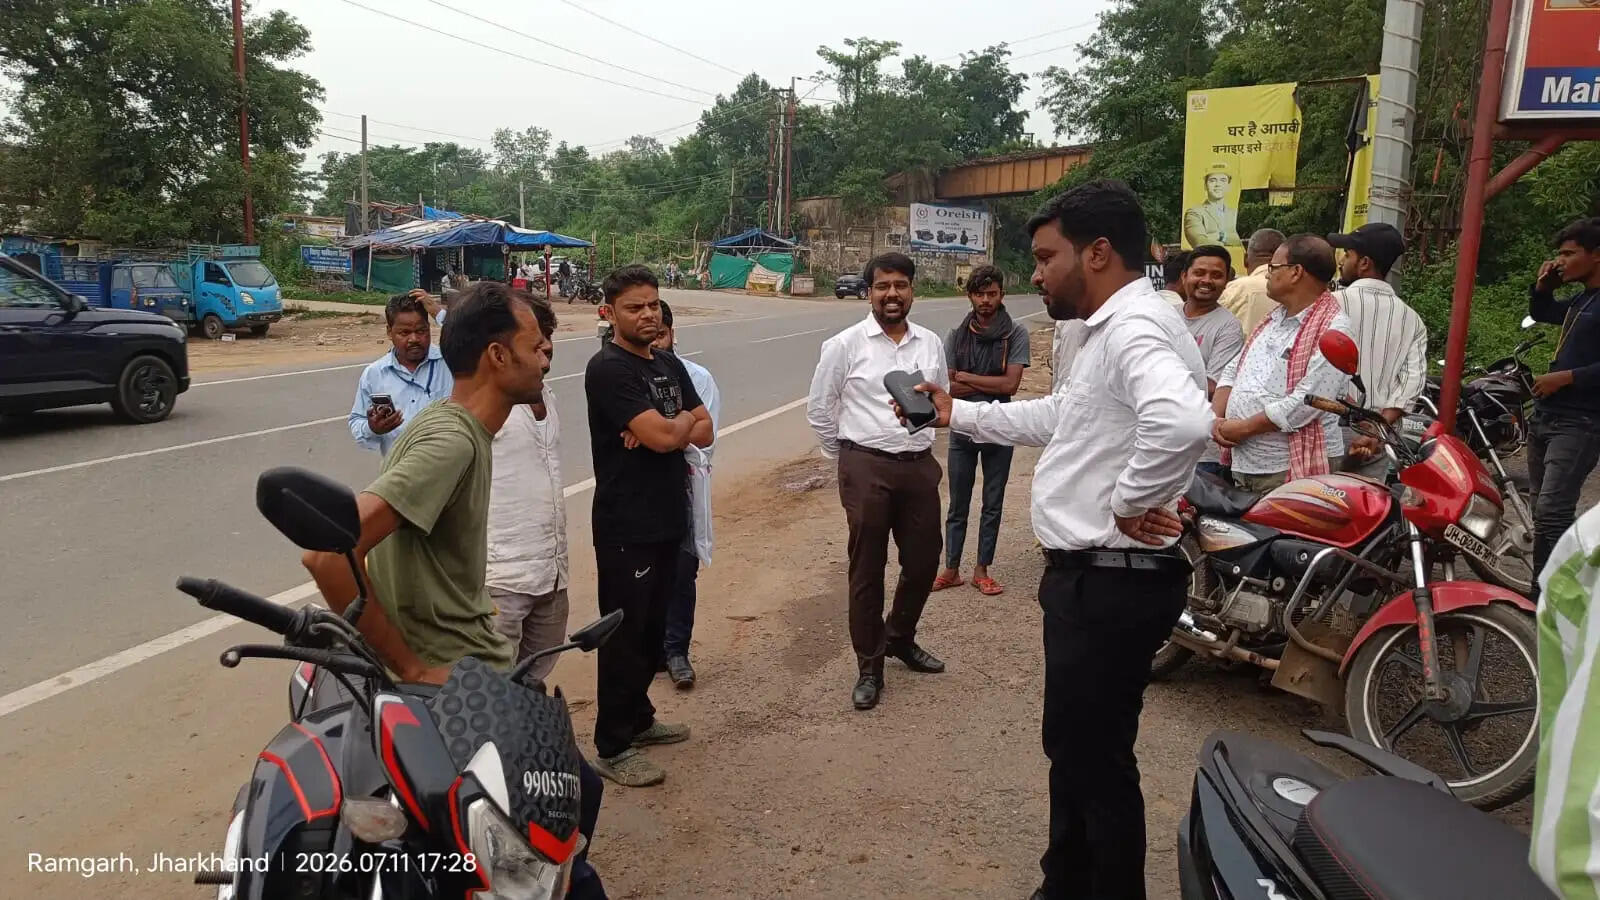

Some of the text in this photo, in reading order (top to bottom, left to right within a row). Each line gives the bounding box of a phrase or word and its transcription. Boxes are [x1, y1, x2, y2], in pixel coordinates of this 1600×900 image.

[1228, 126, 1245, 137] घर
[1248, 121, 1257, 137] है
[1246, 140, 1262, 153] इसे
